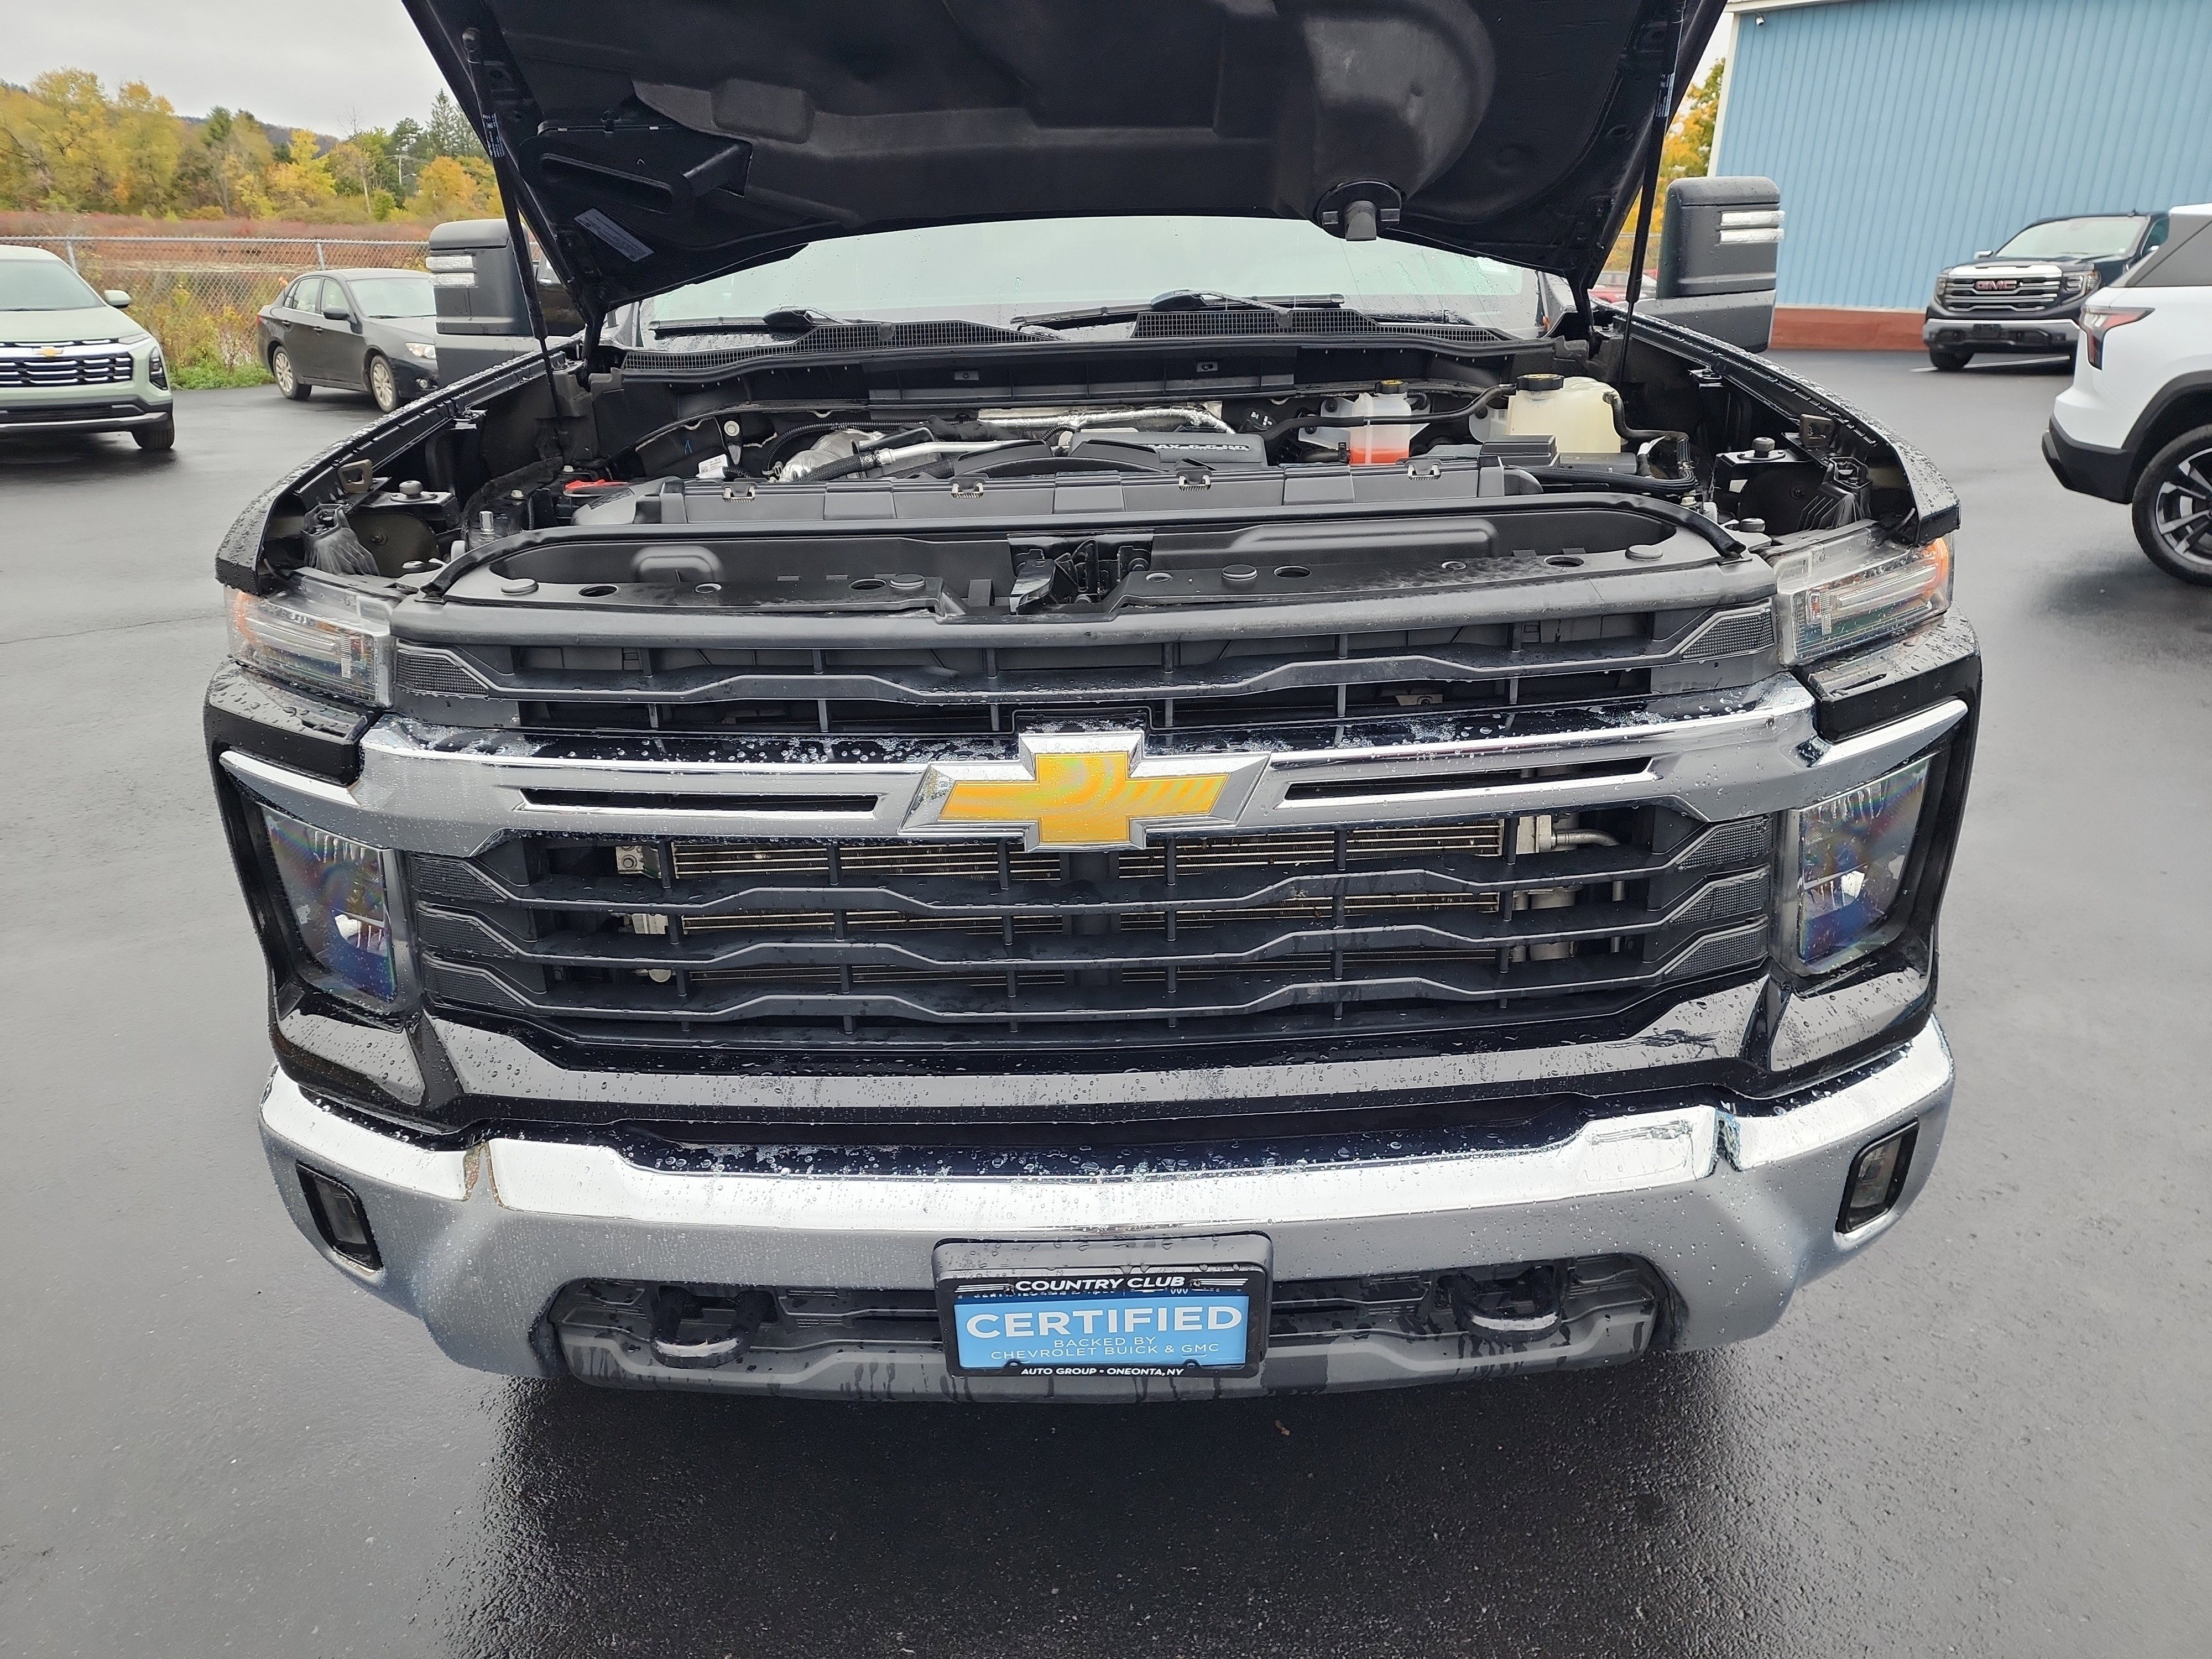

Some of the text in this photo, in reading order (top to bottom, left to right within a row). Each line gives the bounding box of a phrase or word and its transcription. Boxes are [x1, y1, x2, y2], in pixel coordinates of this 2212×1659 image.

[1975, 280, 2017, 290] GMC
[1015, 1276, 1185, 1291] COUNTRY CLUB
[967, 1306, 1242, 1338] CERTIFIED
[1054, 1336, 1156, 1348] BACKED BY
[991, 1343, 1220, 1359] CHEVROLET BUICK & GMC
